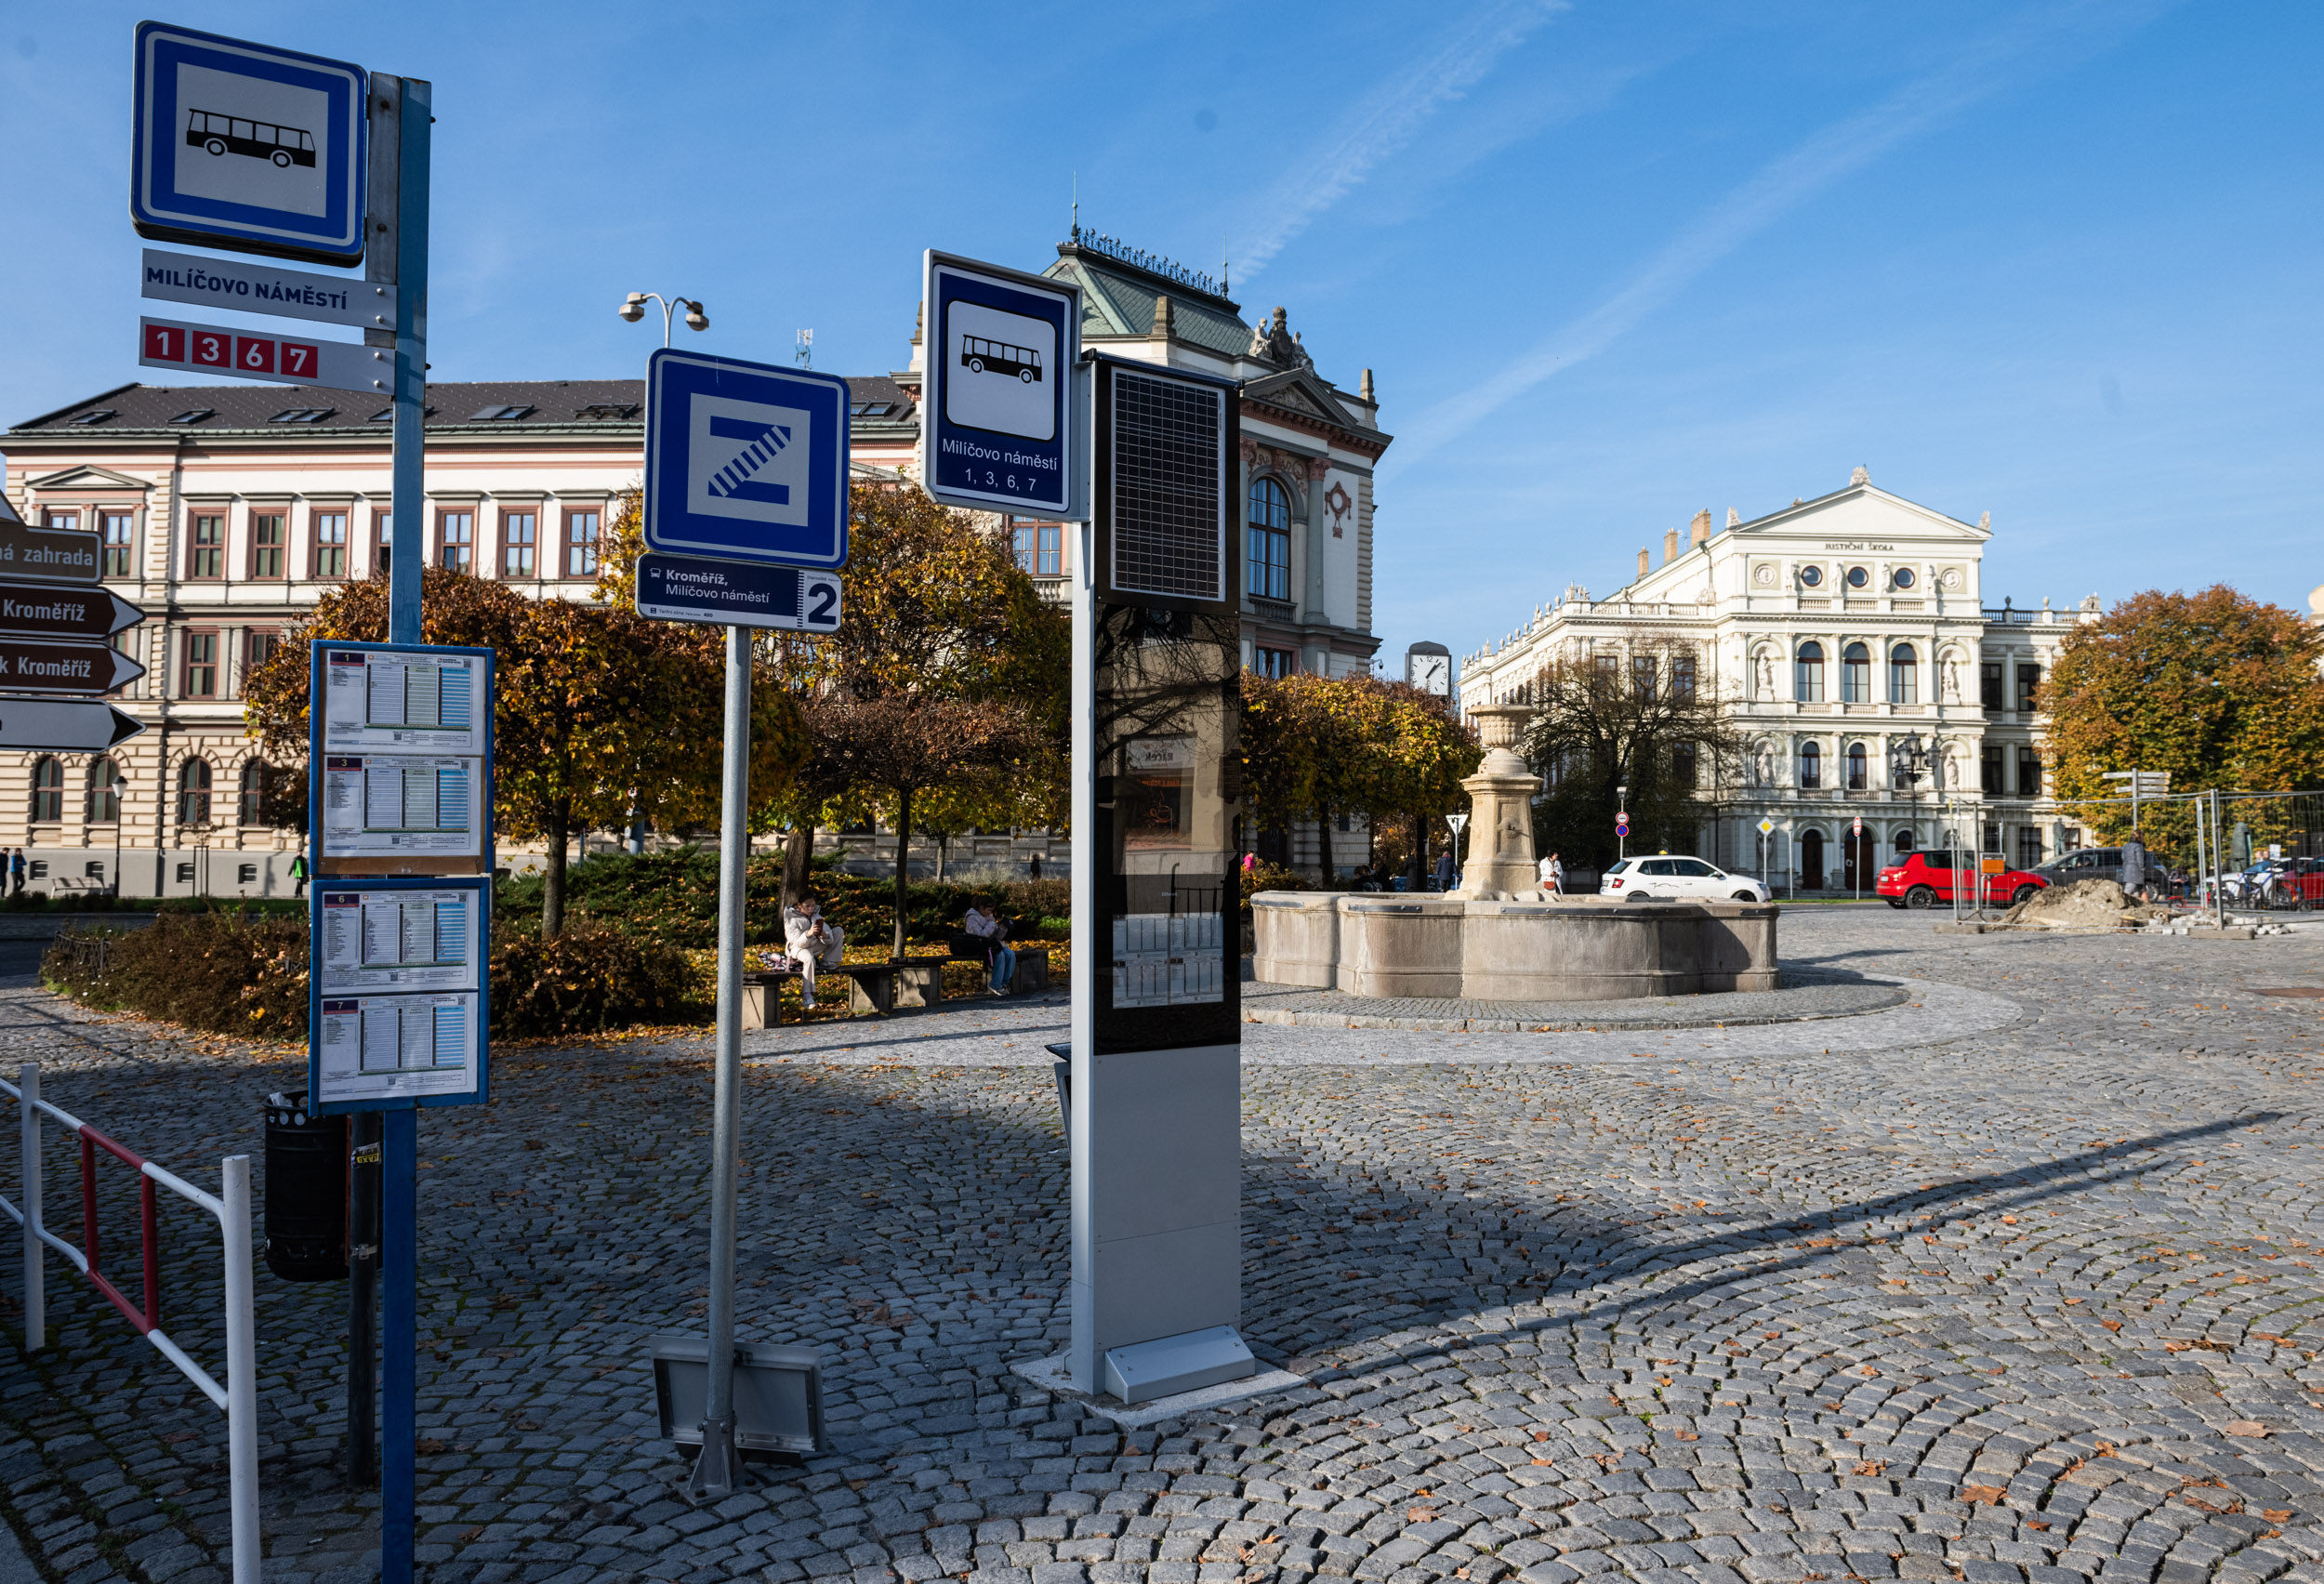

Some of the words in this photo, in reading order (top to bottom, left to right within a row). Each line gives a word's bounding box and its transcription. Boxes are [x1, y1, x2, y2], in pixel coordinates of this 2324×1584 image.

[147, 267, 249, 296] MILÍČOVO
[255, 281, 348, 310] NÁMĚSTÍ
[157, 332, 169, 356] 1
[201, 337, 219, 362] 3
[245, 343, 263, 367] 6
[290, 348, 308, 372] 7
[943, 438, 1000, 461] Milíčovo
[1004, 450, 1058, 470] náměstí
[965, 468, 977, 484] 1,
[985, 471, 998, 488] 3,
[1007, 474, 1020, 492] 6,
[1028, 478, 1037, 492] 7
[23, 546, 94, 566] zahrada
[1825, 541, 1864, 550] JUSTIČNÍ
[1868, 541, 1895, 551] ŠKOLA
[666, 568, 729, 587] Kroměříž,
[666, 583, 719, 599] Milíčovo
[721, 591, 770, 603] náměstí
[3, 599, 86, 622] Kroměříž
[808, 583, 837, 626] 2
[18, 655, 92, 678] Kroměříž
[344, 653, 350, 662] 1
[341, 759, 348, 767] 3
[338, 895, 345, 904] 6
[337, 1001, 343, 1010] 7
